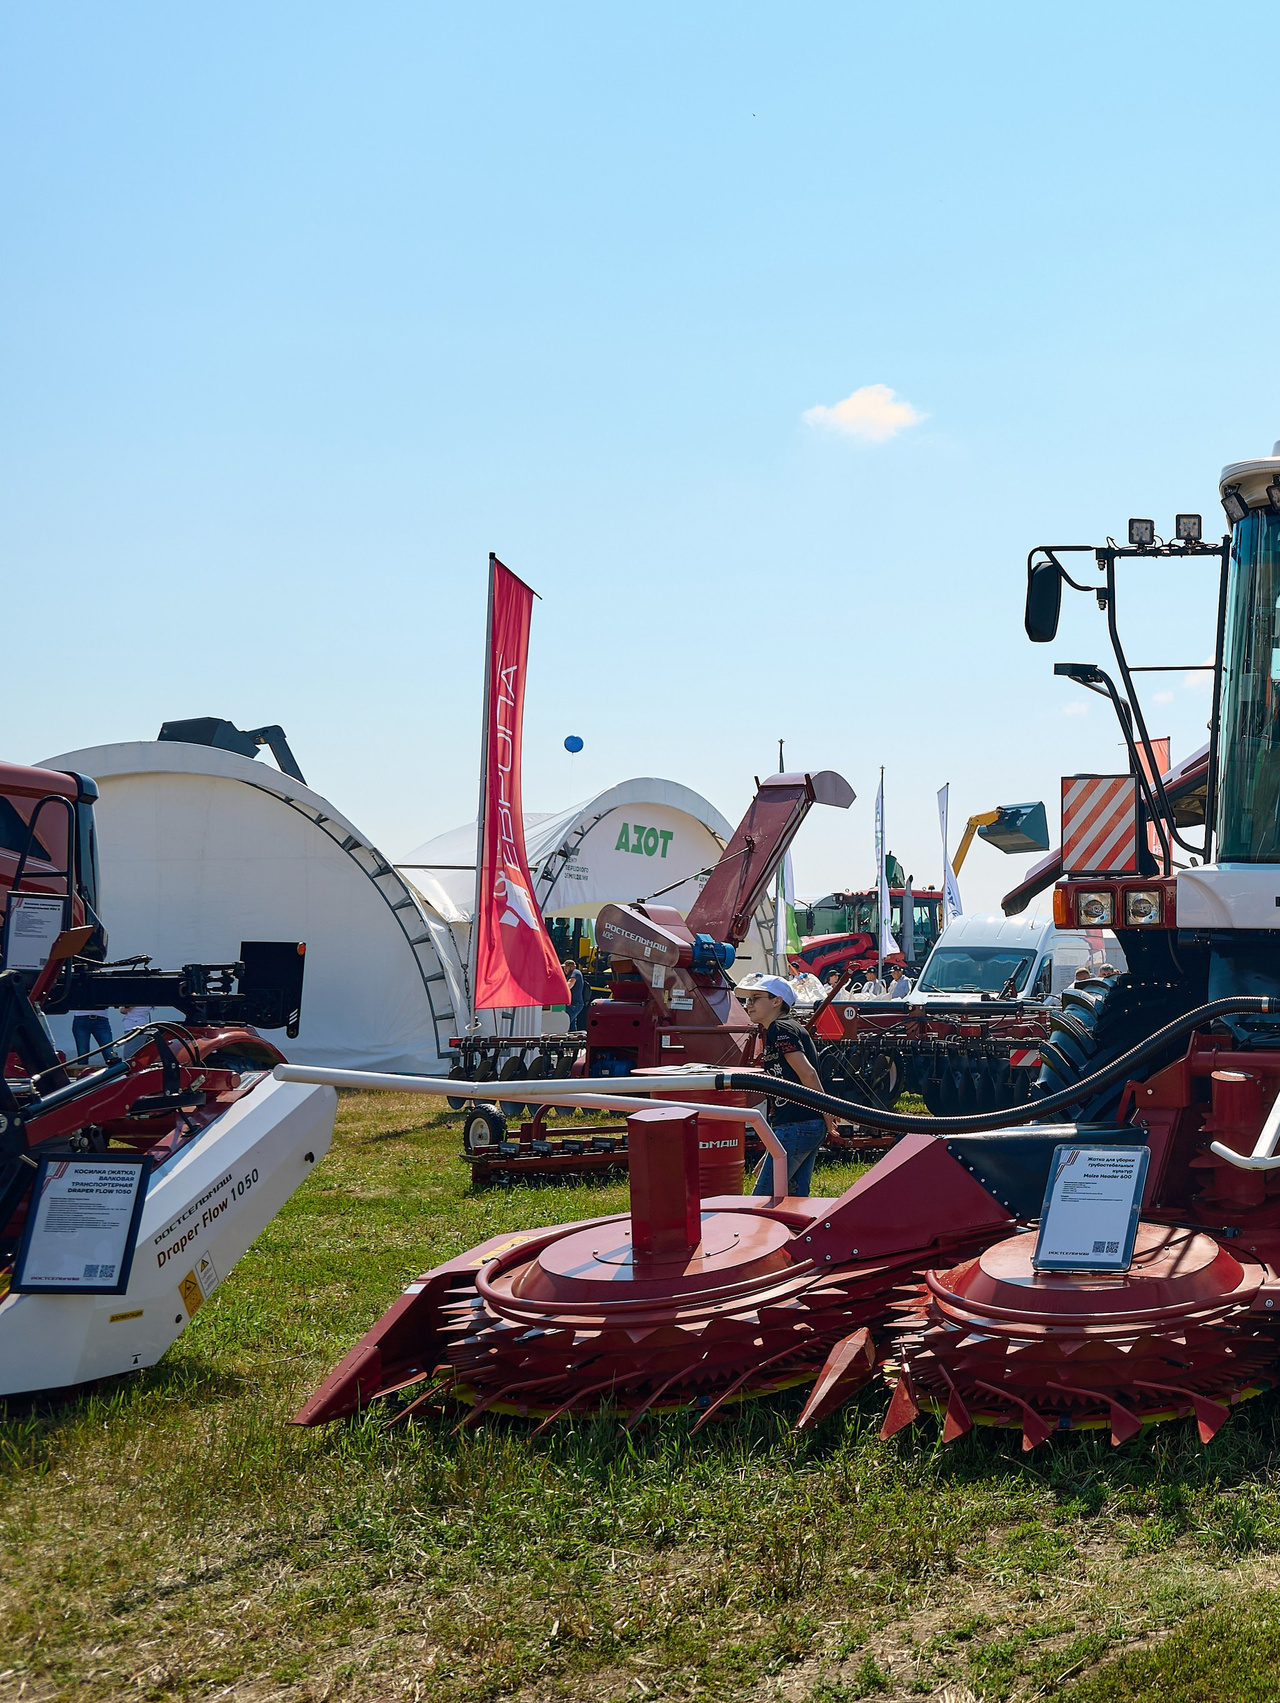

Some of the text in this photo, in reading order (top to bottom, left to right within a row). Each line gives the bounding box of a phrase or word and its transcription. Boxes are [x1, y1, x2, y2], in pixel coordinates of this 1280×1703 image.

[615, 822, 674, 859] АЗОТ
[604, 922, 668, 953] РОСТСЕЛЬМАШ
[846, 1009, 854, 1017] 10
[154, 1173, 233, 1245] РОСТСЕЛЬМАШ
[156, 1168, 260, 1269] Draper Flow 1050
